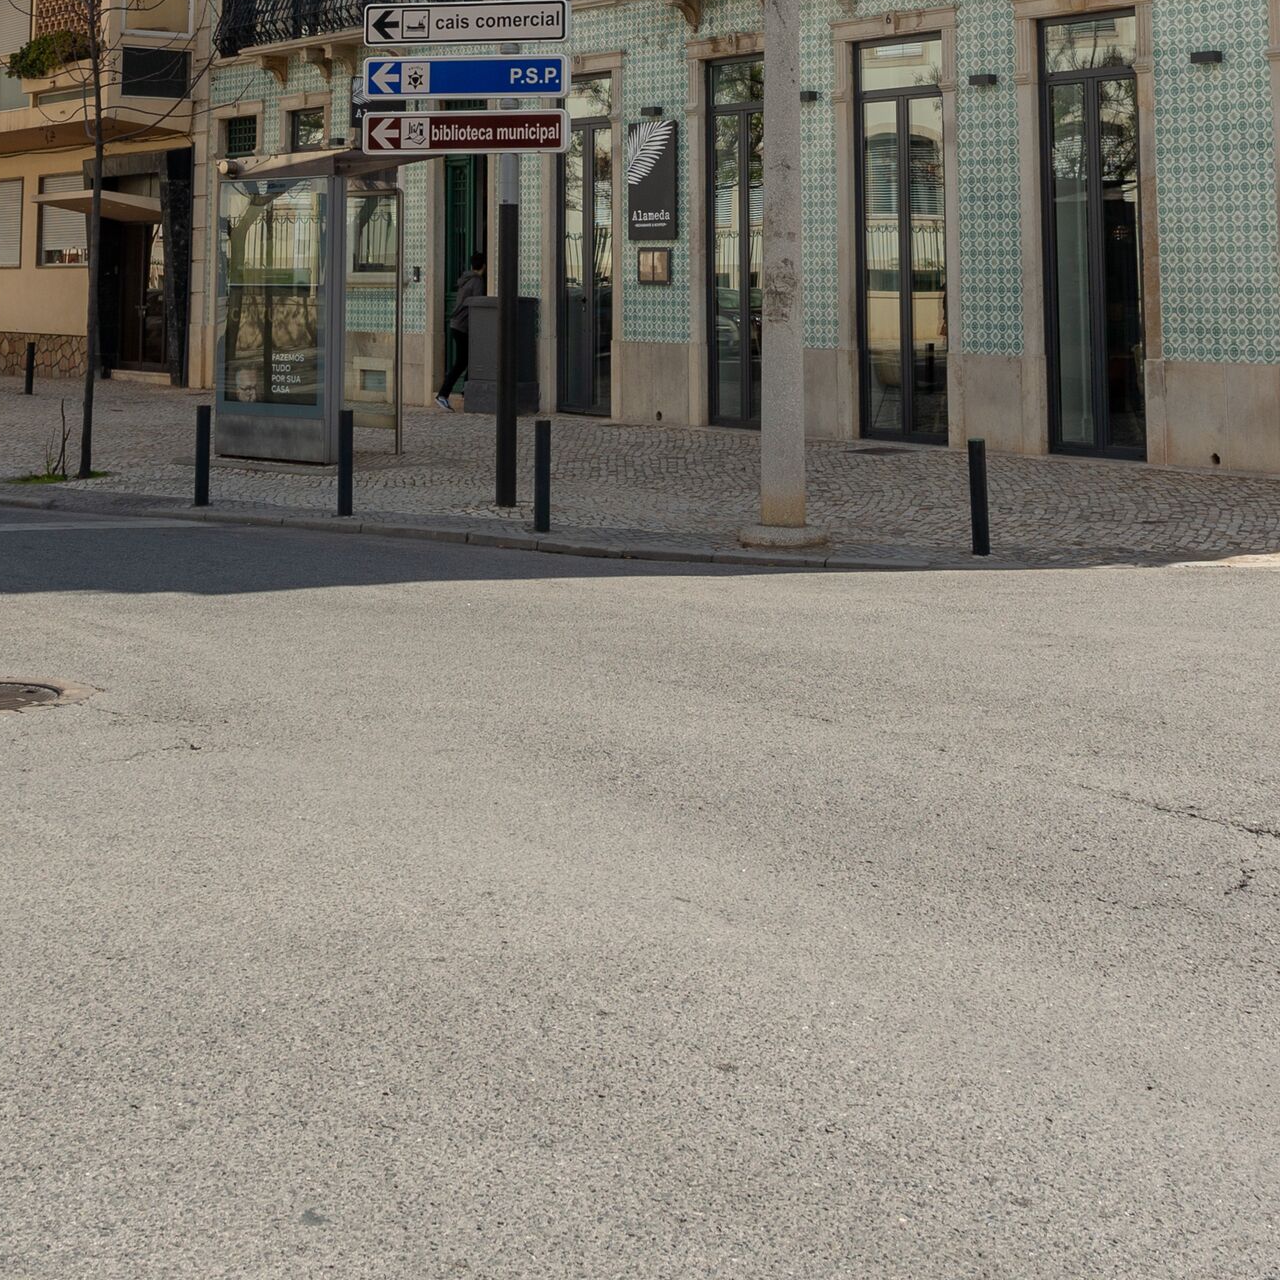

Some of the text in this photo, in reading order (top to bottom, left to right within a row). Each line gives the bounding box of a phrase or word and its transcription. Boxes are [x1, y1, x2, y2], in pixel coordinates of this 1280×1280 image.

[435, 10, 560, 30] cais comercial
[885, 13, 892, 24] 6
[509, 66, 560, 84] P.S.P.
[431, 122, 560, 143] biblioteca municipal
[632, 209, 671, 221] Alameda
[272, 353, 305, 362] FAZEMOS
[272, 364, 291, 372] TUDO
[272, 375, 286, 383] POR
[271, 385, 290, 393] CASA
